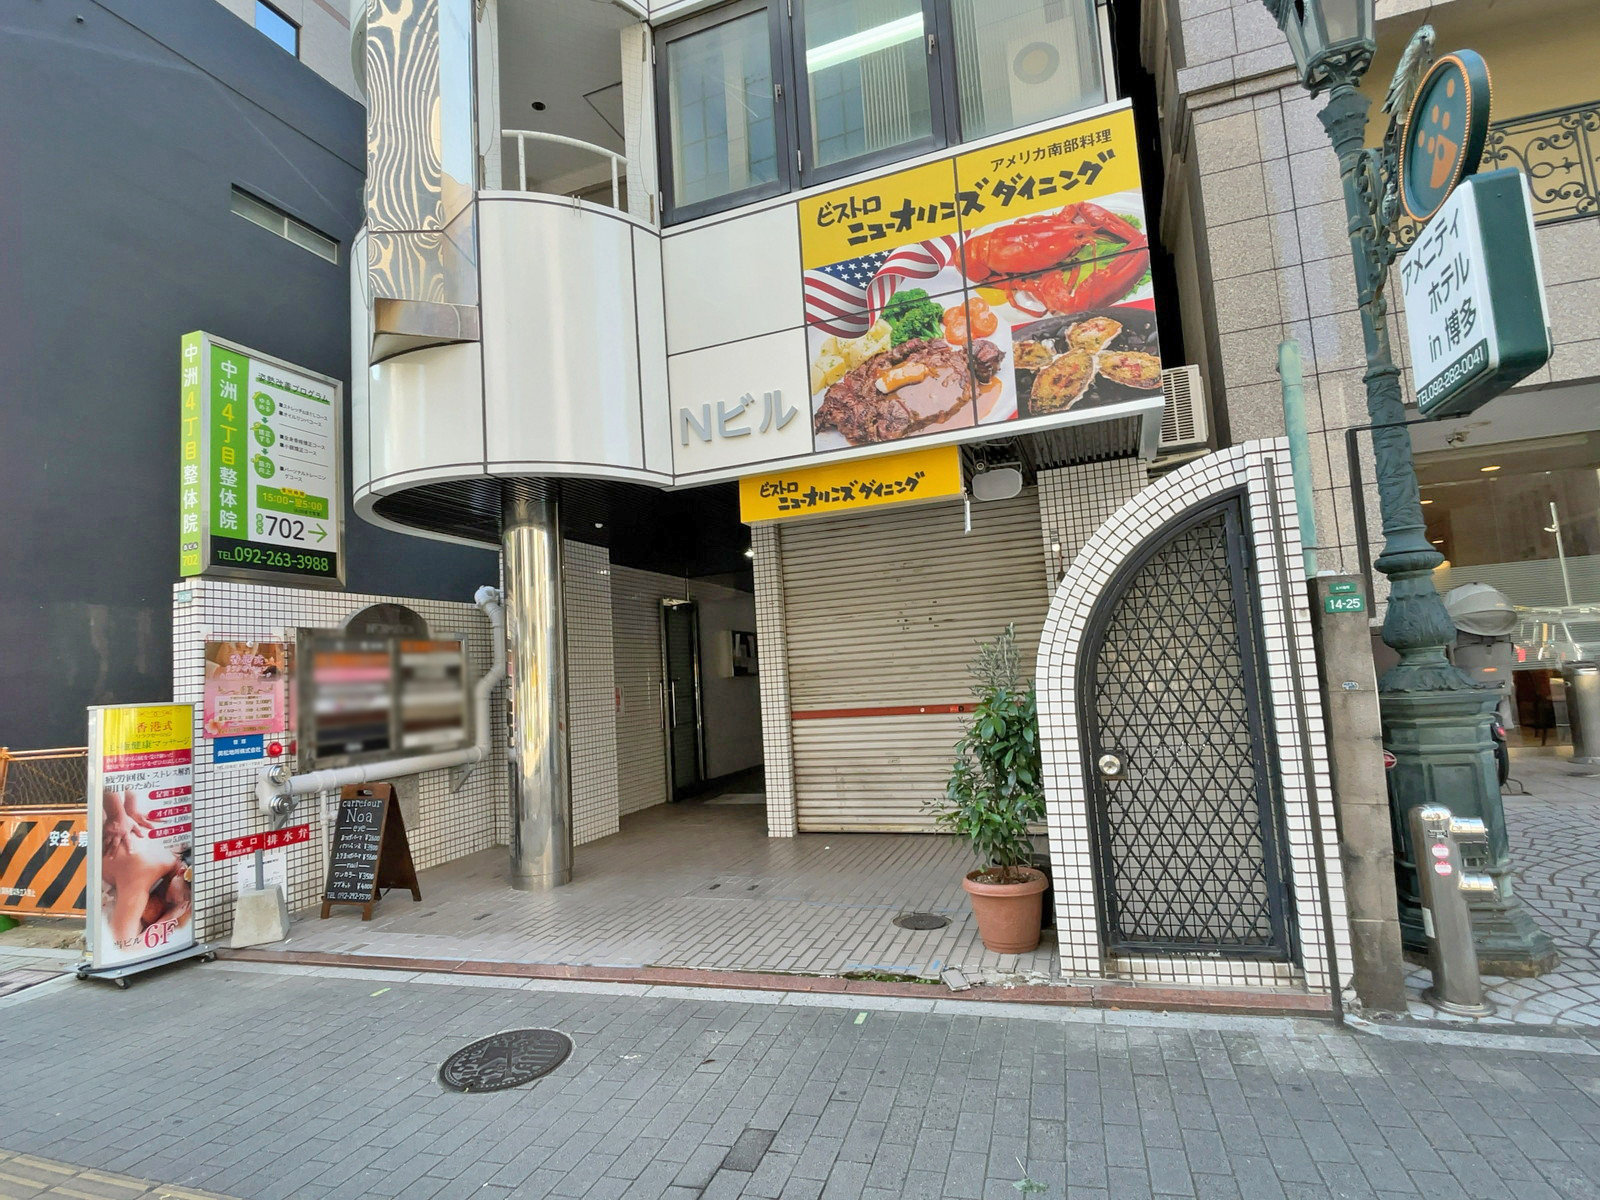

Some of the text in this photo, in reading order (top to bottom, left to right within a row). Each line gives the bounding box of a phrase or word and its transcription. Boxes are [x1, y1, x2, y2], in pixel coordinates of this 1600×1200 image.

[990, 128, 1112, 172] アメリカ南部料理
[991, 149, 1117, 207] ダイニング
[817, 195, 881, 228] ビストロ
[1402, 207, 1459, 296] アメニティ
[1428, 251, 1470, 315] ホテル
[1428, 296, 1477, 363] in 博多
[680, 389, 799, 446] Nビル
[184, 343, 199, 534] 中洲4丁目整体院
[219, 359, 238, 531] 中洲4丁目整体院
[759, 479, 799, 498] ビストロ
[859, 470, 926, 500] ダイニング
[265, 515, 305, 541] 702
[1330, 598, 1361, 610] 14-25
[137, 720, 173, 734] 香港式
[342, 799, 382, 808] carrefour
[345, 808, 373, 824] Noa
[49, 830, 71, 847] 安全
[352, 825, 366, 833] eye
[144, 918, 179, 949] 6F
